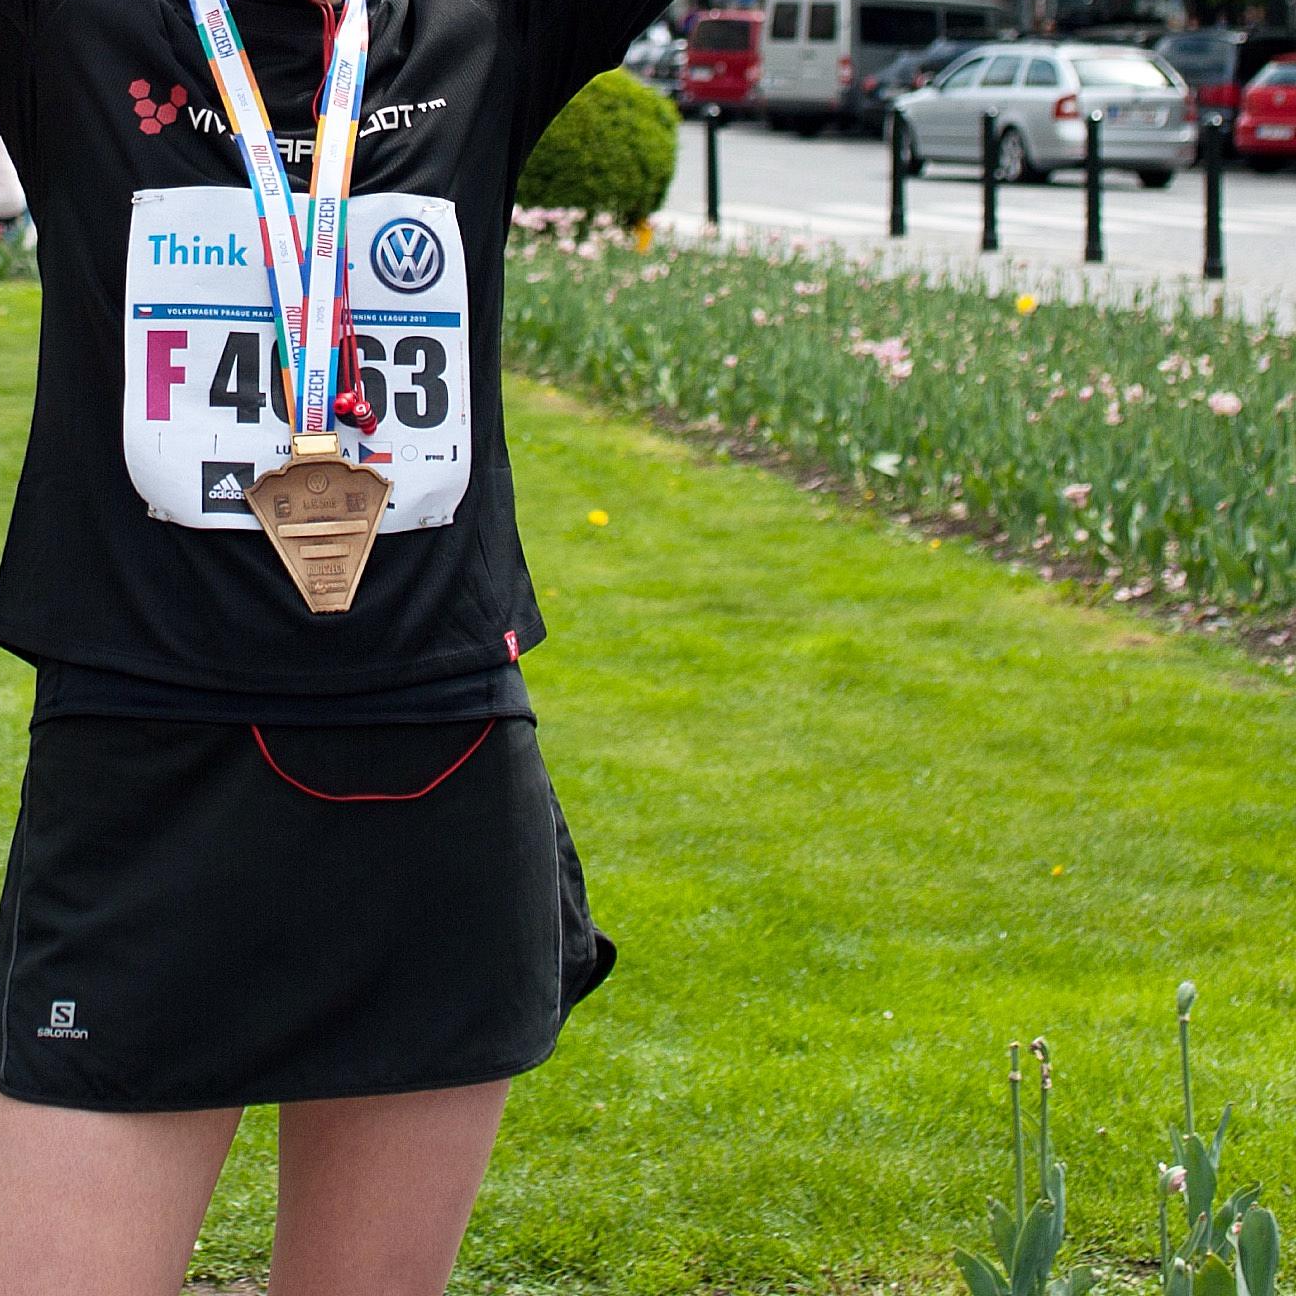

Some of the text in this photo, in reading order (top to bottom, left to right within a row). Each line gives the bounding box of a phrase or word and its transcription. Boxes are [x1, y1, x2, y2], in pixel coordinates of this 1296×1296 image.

[206, 9, 234, 59] RUNCZECH
[333, 59, 353, 110] RUNCZECH
[251, 144, 280, 196] RUNCZECH
[148, 233, 248, 266] Think
[316, 197, 336, 258] RUNCZECH
[167, 308, 219, 316] VOLKSWAGEN
[221, 309, 250, 317] PRAGUE
[252, 310, 273, 318] MARA
[285, 305, 303, 368] RUNCZE
[146, 330, 188, 421] F
[307, 369, 325, 432] RUNCZECH
[37, 1028, 88, 1039] salomon
